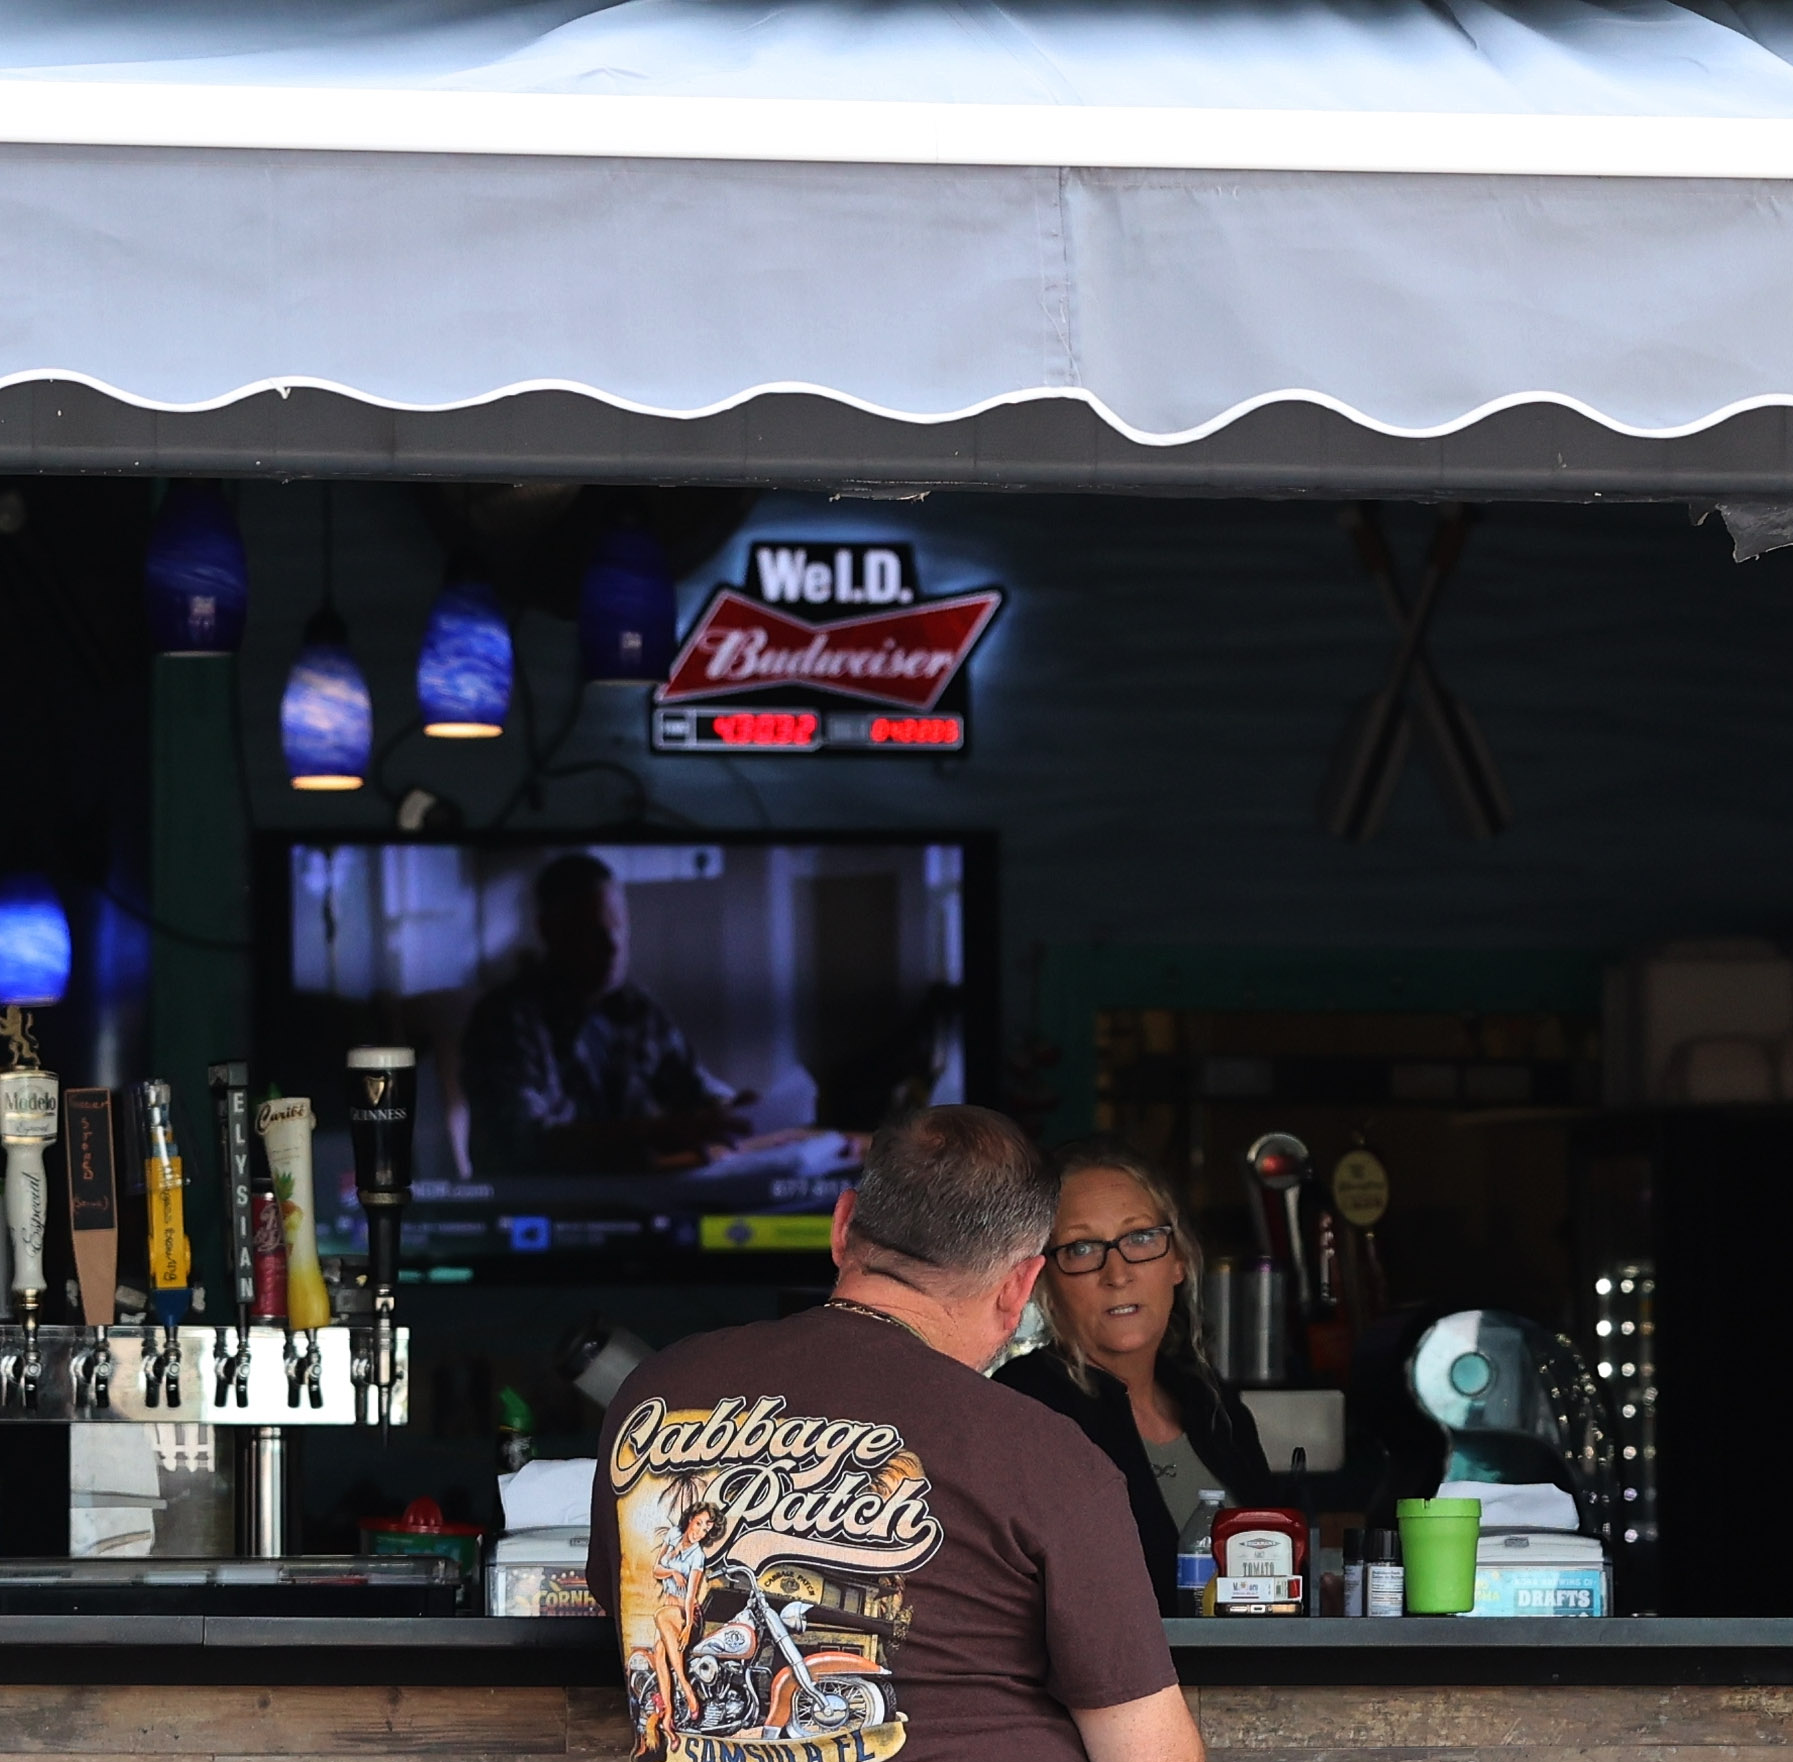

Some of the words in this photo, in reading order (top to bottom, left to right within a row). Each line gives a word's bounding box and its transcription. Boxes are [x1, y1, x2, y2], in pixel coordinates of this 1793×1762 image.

[698, 626, 956, 682] Budweiser
[4, 1091, 57, 1113] Modelo
[232, 1091, 255, 1298] ELYSIAN
[610, 1396, 904, 1494] Cabbage
[703, 1458, 943, 1568] Patch
[1242, 1561, 1275, 1577] TOMATO
[1518, 1589, 1591, 1608] DRAFTS
